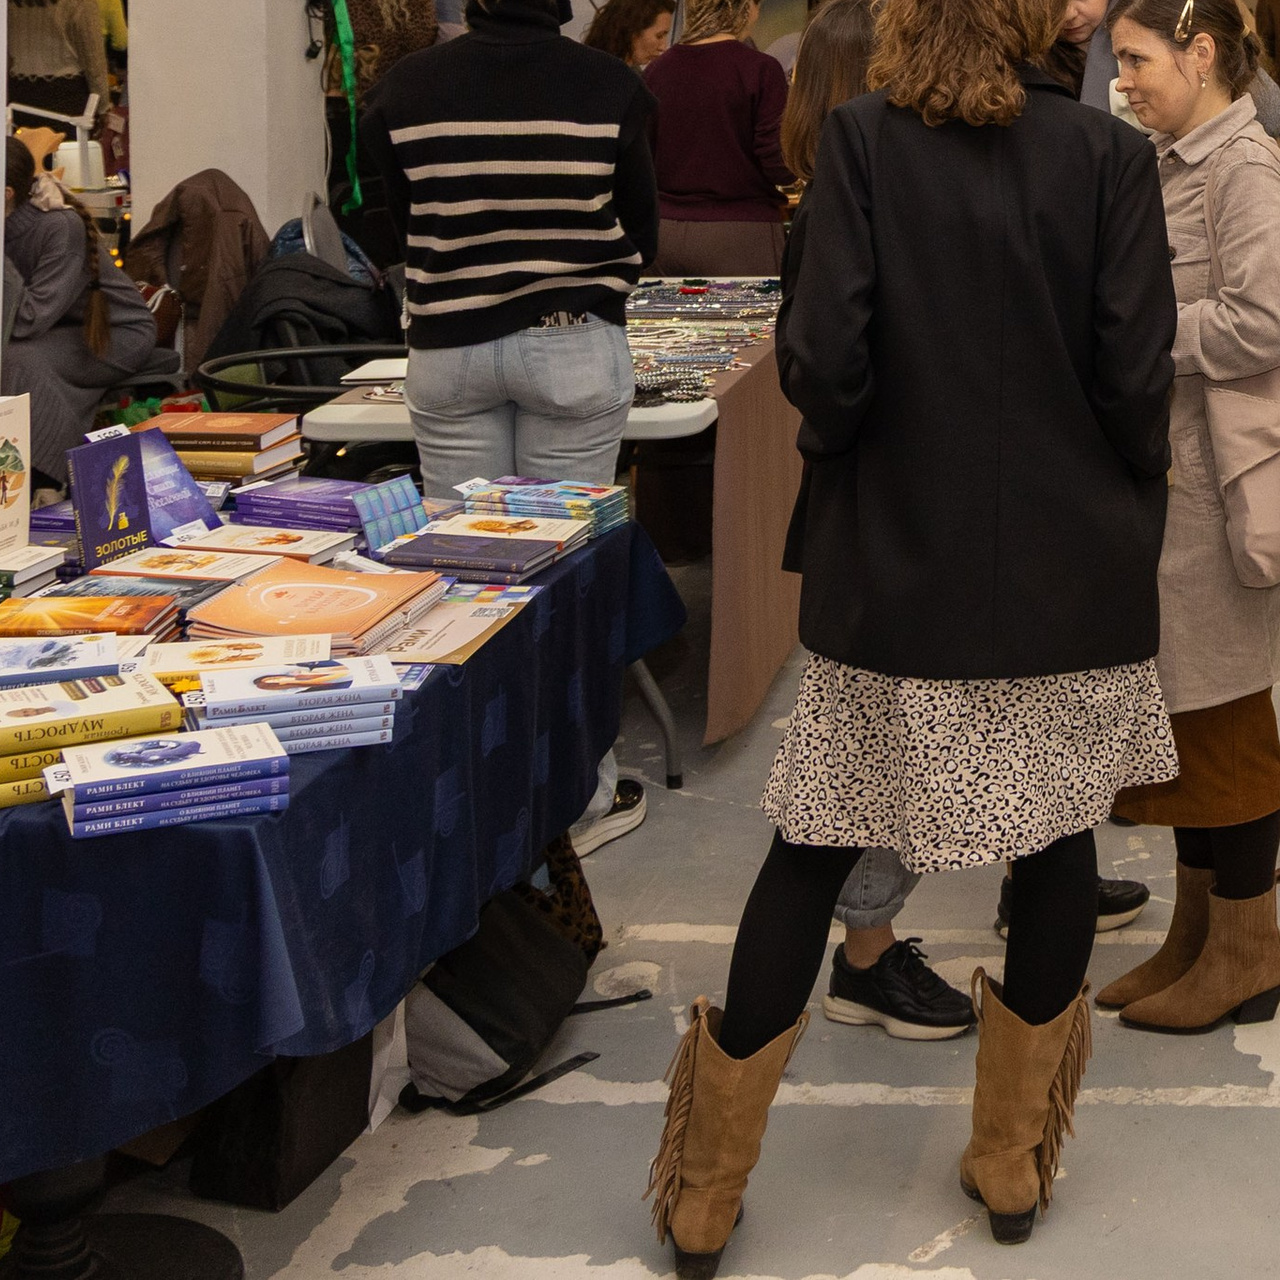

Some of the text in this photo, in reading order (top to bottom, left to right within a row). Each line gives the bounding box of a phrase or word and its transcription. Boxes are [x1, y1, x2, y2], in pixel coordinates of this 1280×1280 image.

[95, 530, 148, 558] ЗОЛОТЫЕ
[298, 693, 362, 707] ВТОРАЯ ЖЕНА
[290, 709, 355, 723] ВТОРАЯ ЖЕНА
[14, 718, 104, 743] МУДРОСТЬ
[289, 723, 353, 738] ВТОРАЯ ЖЕНА
[287, 737, 351, 752] ВТОРАЯ ЖЕНА
[10, 753, 63, 770] РОСТЬ
[217, 765, 242, 774] ПЛАНЕТ
[86, 785, 113, 795] РАМИ
[116, 780, 146, 791] БЛЕКТ
[217, 785, 242, 794] ПЛАНЕТ
[86, 800, 145, 814] РАМИ БЛЕКТ
[216, 802, 241, 811] ПЛАНЕТ
[85, 817, 145, 832] РАМИ БЛЕКТ
